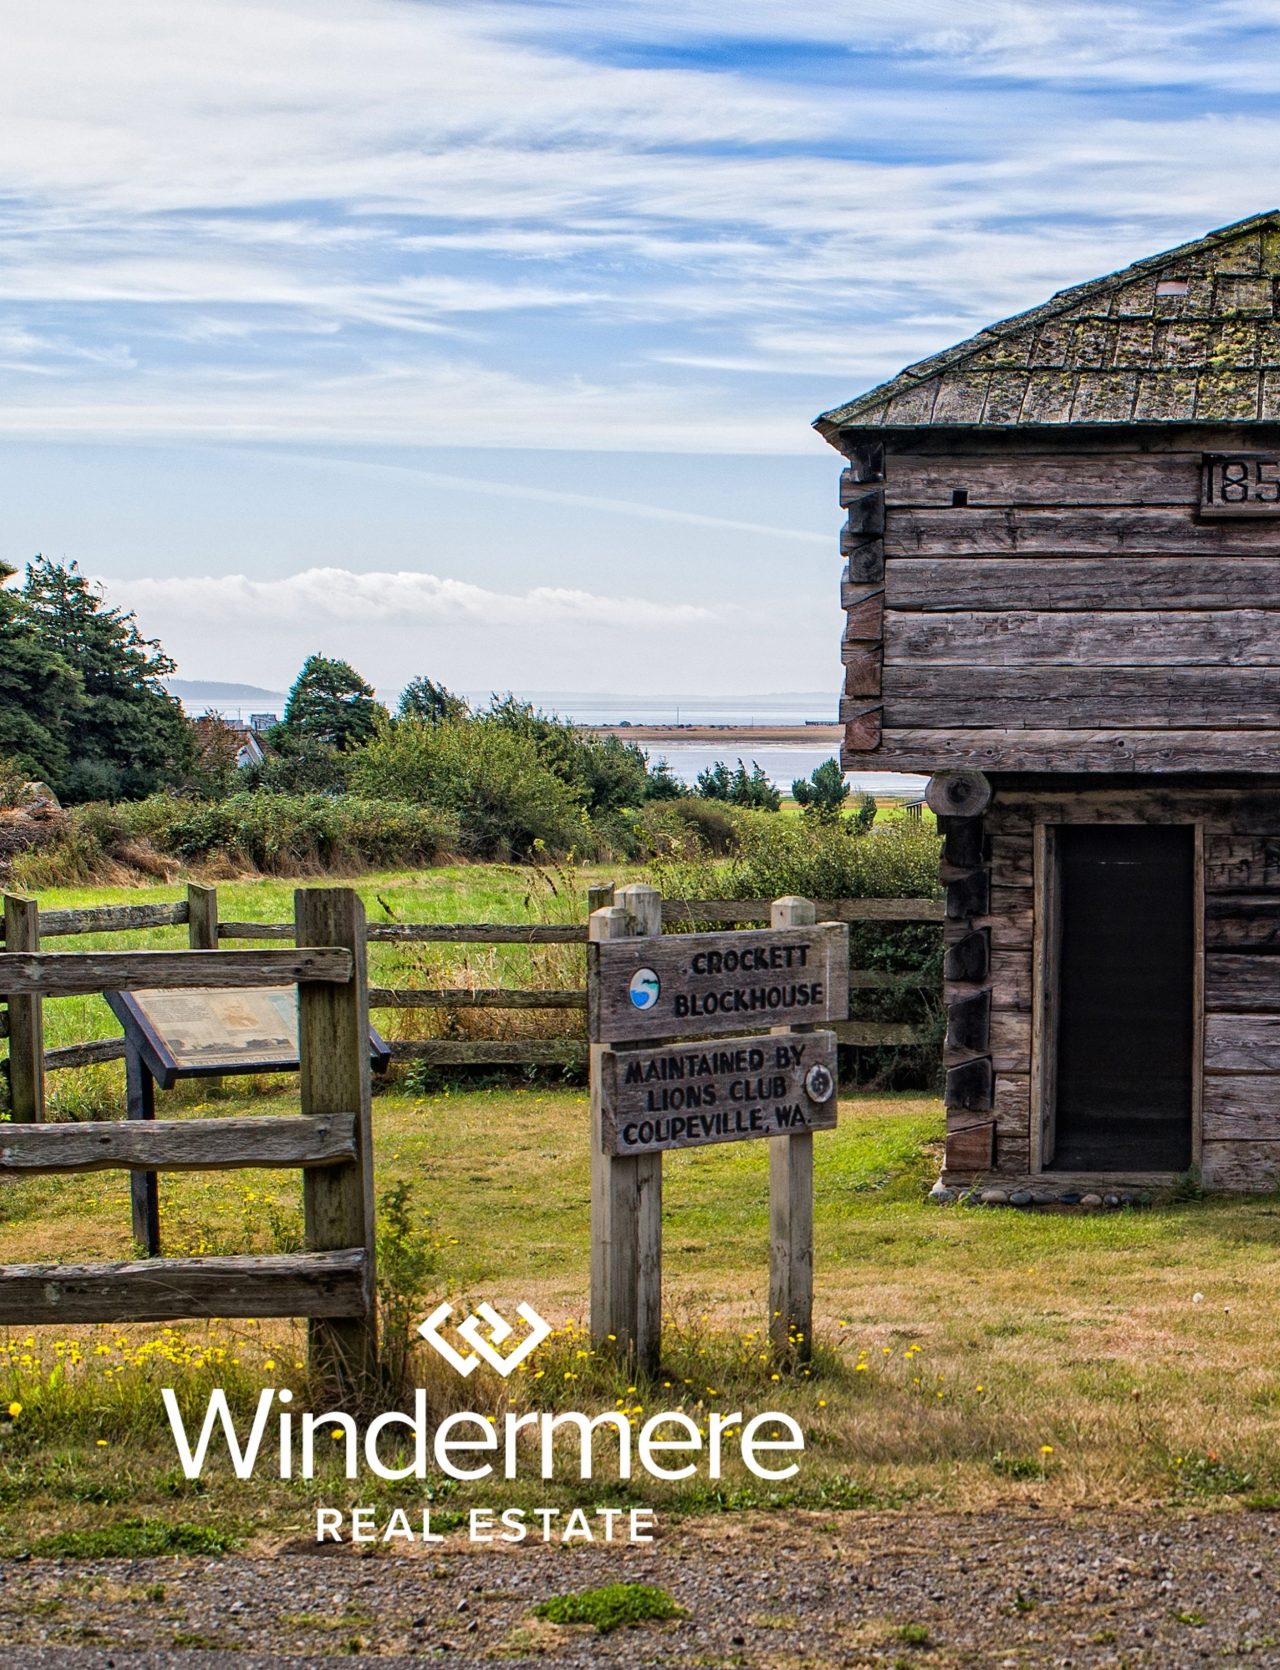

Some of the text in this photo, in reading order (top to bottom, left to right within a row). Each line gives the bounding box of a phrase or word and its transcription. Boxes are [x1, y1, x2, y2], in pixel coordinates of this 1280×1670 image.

[691, 944, 810, 975] CROCKETT
[674, 982, 823, 1017] BLOCKHOUSE
[624, 1044, 806, 1084] MAINTAINED BY
[647, 1076, 786, 1112] LIONS CLUB
[622, 1108, 770, 1145] COUPEVILLE,
